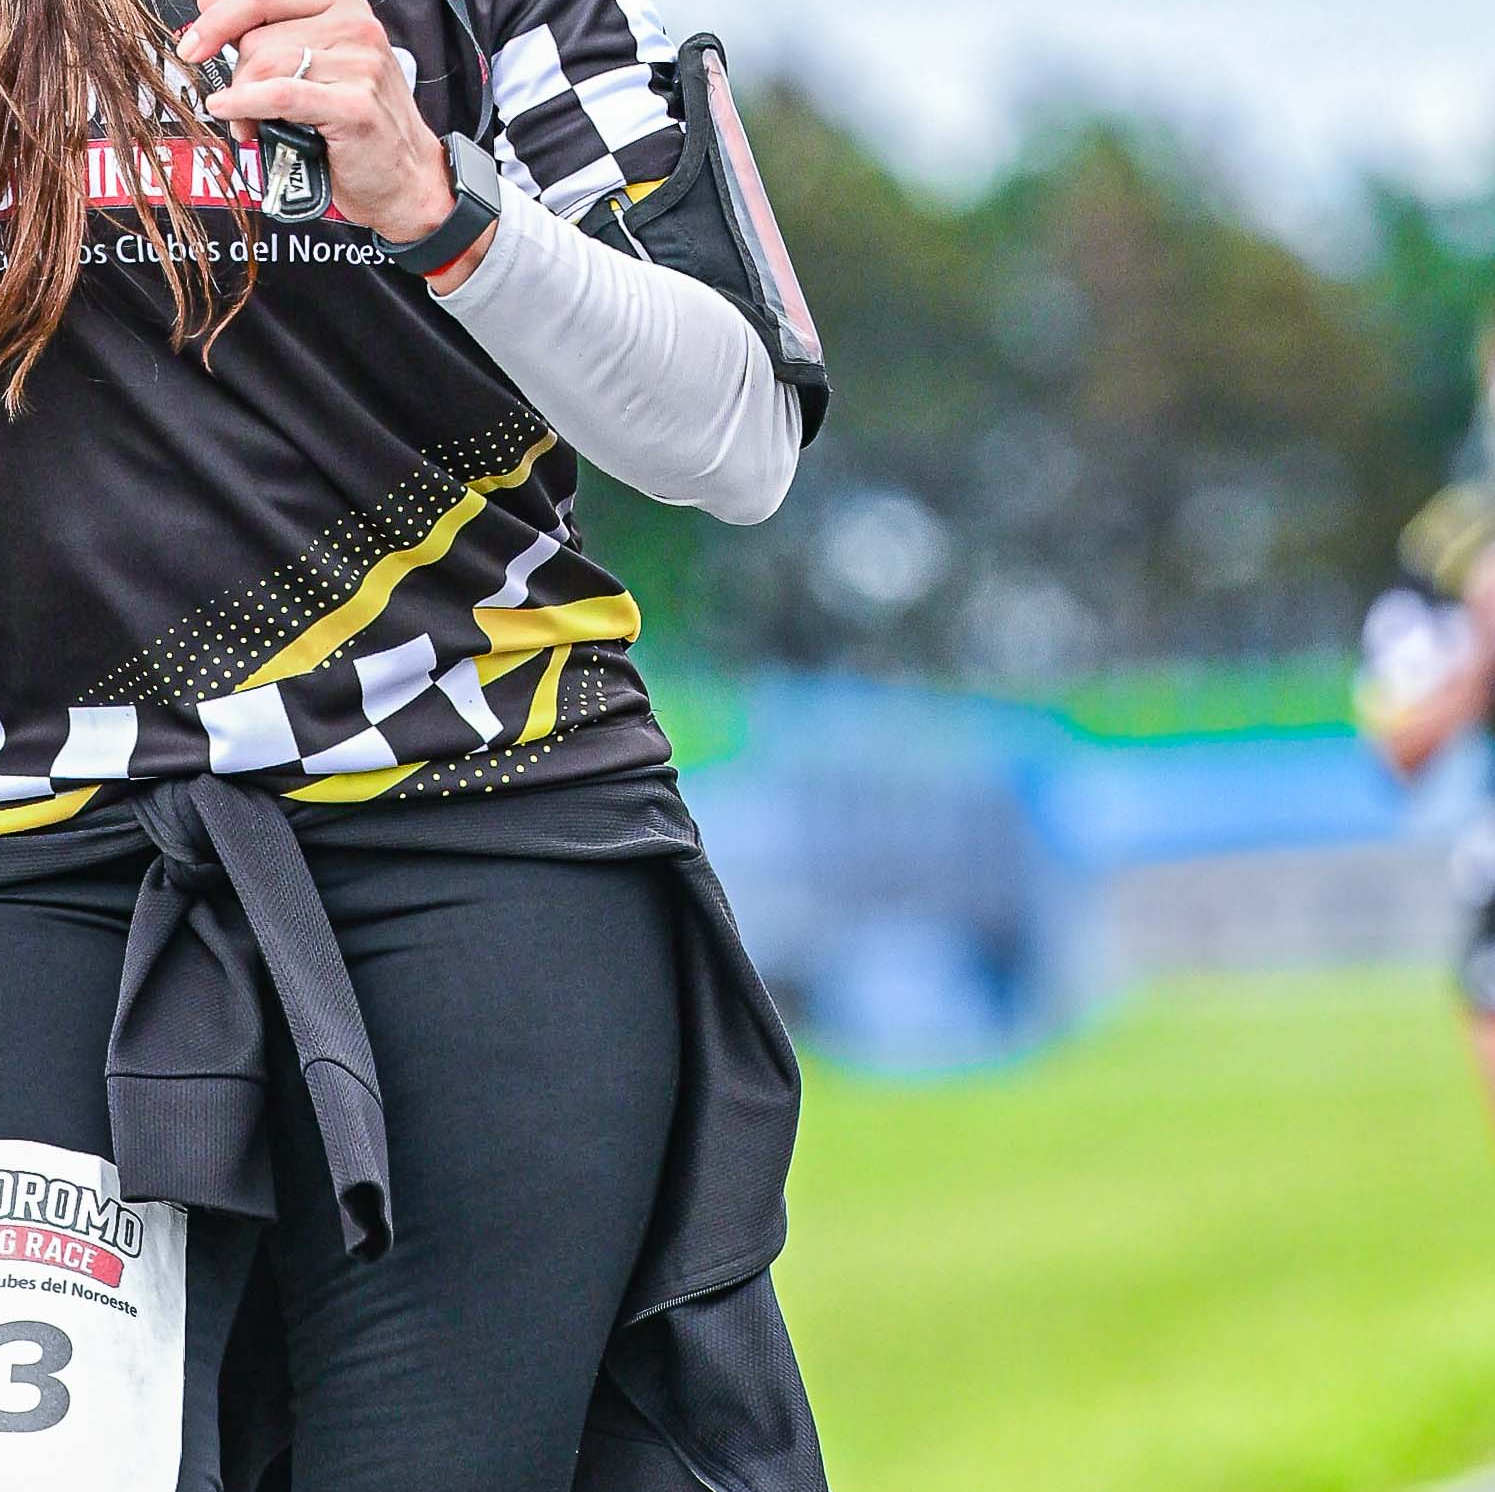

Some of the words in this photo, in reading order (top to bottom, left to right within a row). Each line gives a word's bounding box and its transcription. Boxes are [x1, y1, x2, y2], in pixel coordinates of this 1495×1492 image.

[79, 241, 108, 265] os
[229, 233, 278, 263] del
[288, 233, 396, 265] Noroes
[25, 1232, 99, 1275] RACE
[41, 1277, 67, 1295] del
[71, 1283, 139, 1318] Noroeste
